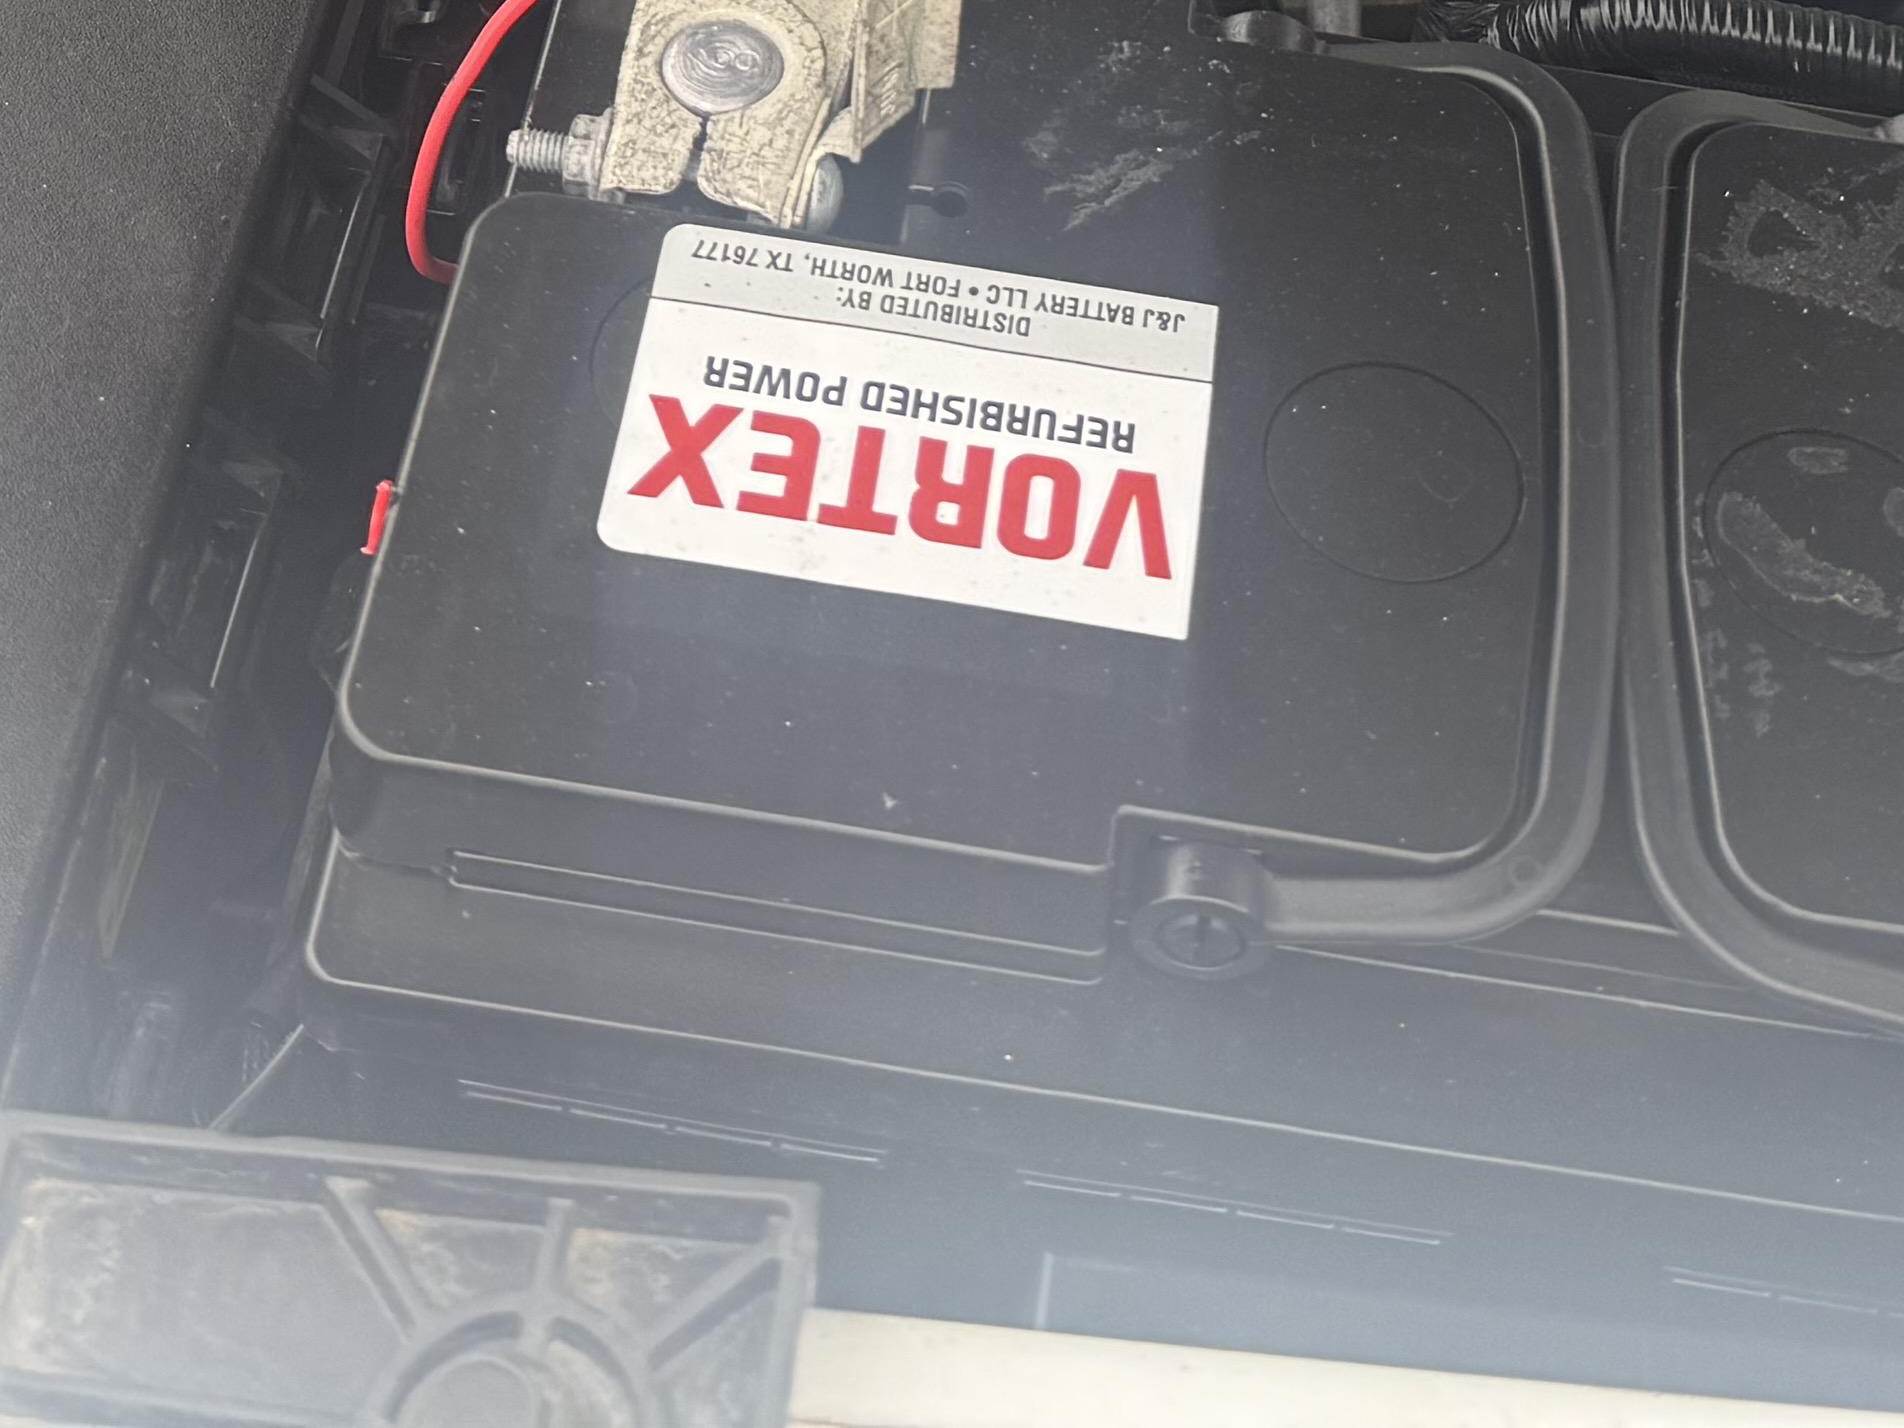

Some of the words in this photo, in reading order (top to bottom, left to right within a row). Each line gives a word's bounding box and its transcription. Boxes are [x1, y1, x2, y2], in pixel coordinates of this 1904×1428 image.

[690, 237, 761, 270] 76177
[764, 248, 796, 277] TX
[803, 252, 896, 291] WORTH,
[901, 270, 962, 300] FORT
[834, 285, 874, 312] BY:
[986, 282, 1031, 312] LLC
[1033, 292, 1136, 328] BATTERY
[879, 291, 1032, 339] DISTRIBUTED
[1139, 308, 1186, 336] J&J
[702, 355, 849, 408] POWER
[859, 380, 1136, 456] REFURBISHED
[626, 395, 1173, 581] VORTEX
